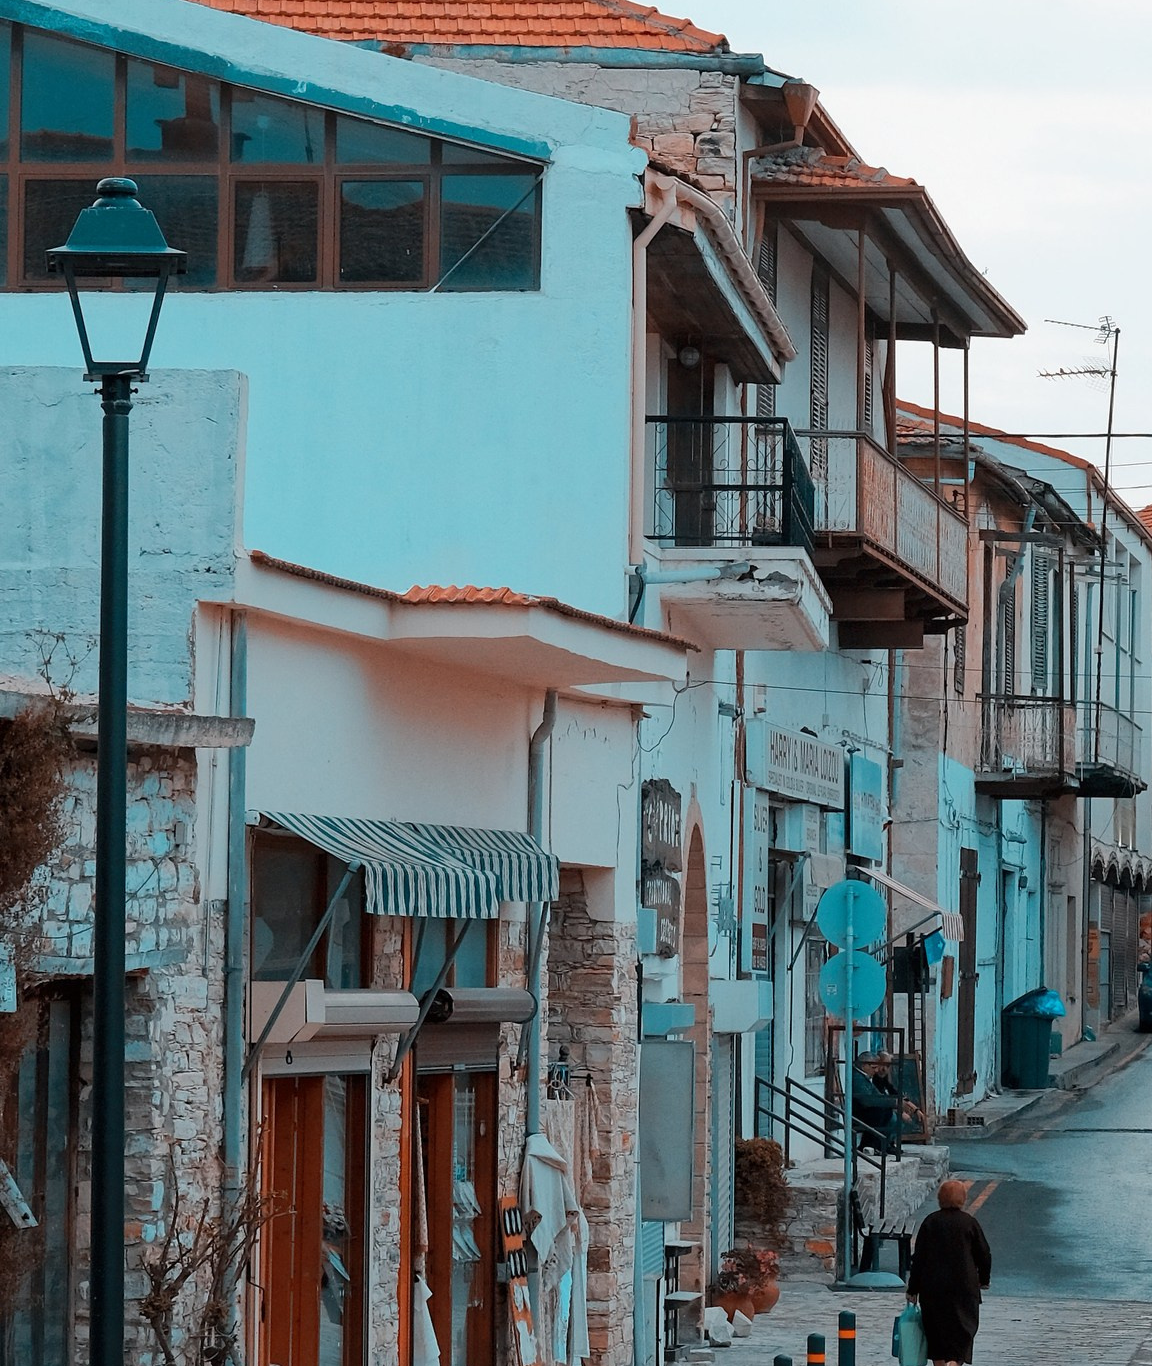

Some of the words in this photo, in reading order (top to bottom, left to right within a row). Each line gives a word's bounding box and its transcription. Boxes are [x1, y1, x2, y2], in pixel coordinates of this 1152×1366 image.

[770, 730, 791, 770] HARRY
[800, 740, 818, 777] MARIA
[820, 747, 839, 784] LOIZOU
[754, 803, 767, 833] SILVER
[754, 885, 765, 914] GOLD
